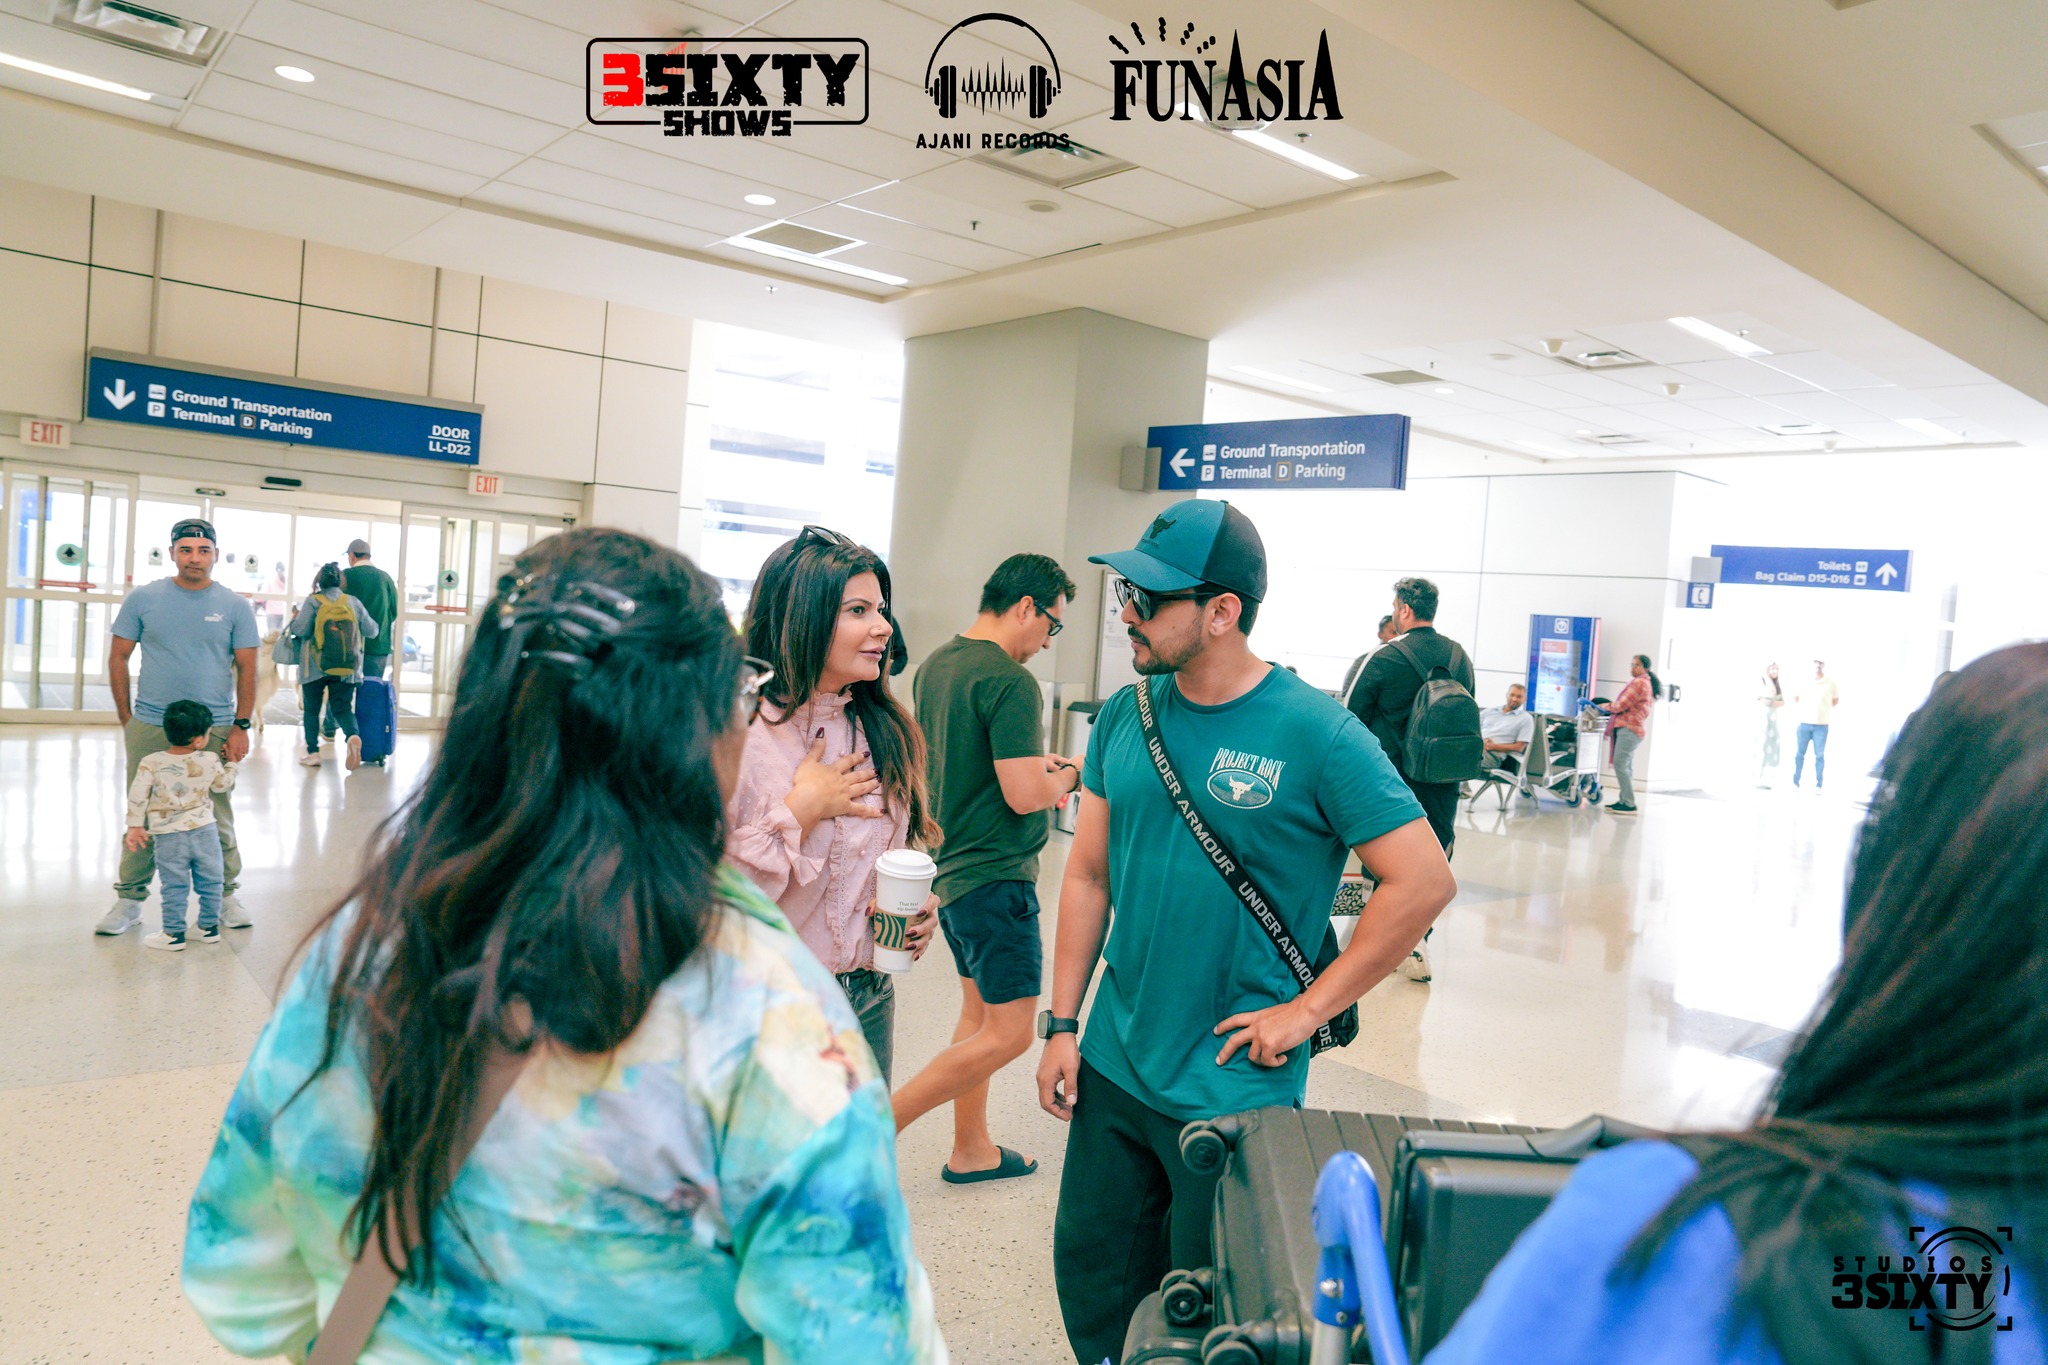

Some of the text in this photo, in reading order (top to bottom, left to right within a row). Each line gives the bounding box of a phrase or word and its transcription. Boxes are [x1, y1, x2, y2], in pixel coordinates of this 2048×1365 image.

[172, 389, 332, 422] Ground Transportation
[171, 406, 236, 427] Terminal
[259, 418, 313, 439] Parking
[31, 421, 64, 445] EXIT
[432, 424, 470, 440] DOOR
[428, 440, 471, 456] LL-D22
[1220, 441, 1365, 459] Ground Transportation
[1219, 465, 1271, 479] Terminal
[1295, 464, 1346, 480] Parking
[475, 475, 499, 494] EXIT
[1818, 561, 1852, 571] Toilets
[1755, 571, 1851, 584] Bag Claim D15-D16
[1209, 747, 1287, 791] PROJECT ROCK
[1148, 736, 1182, 797] UNDER
[1177, 799, 1236, 876] ARMOUR
[1238, 881, 1282, 937] UNDER
[1277, 936, 1315, 989] ARMOU
